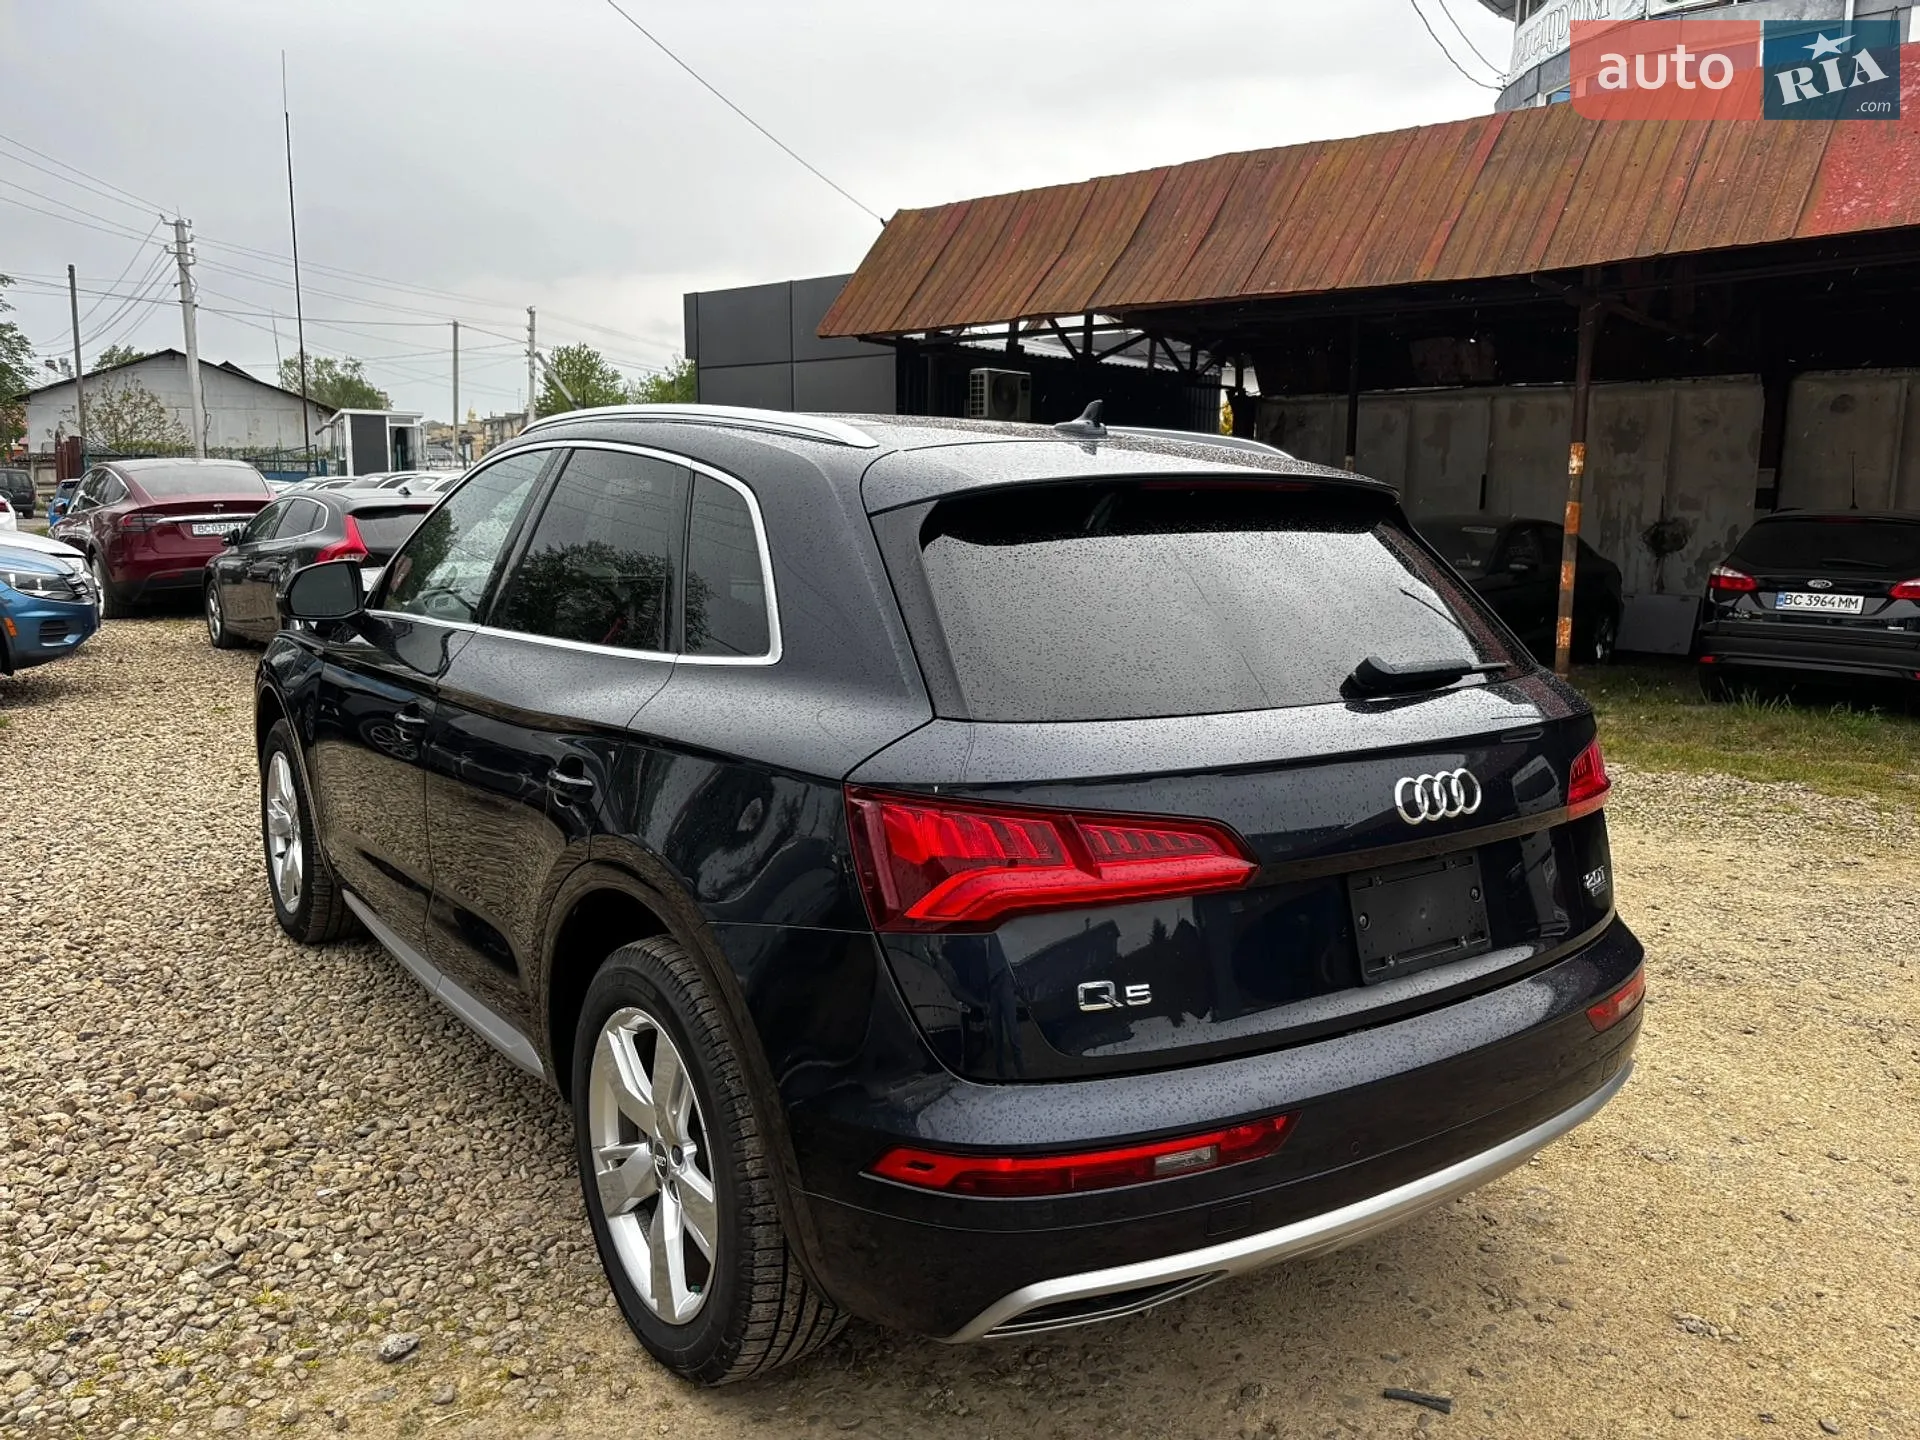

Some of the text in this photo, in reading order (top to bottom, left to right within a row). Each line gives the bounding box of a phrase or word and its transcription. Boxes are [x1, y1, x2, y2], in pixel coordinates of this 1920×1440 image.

[1784, 593, 1859, 609] BC 3964 MM
[1077, 980, 1152, 1011] Q5
